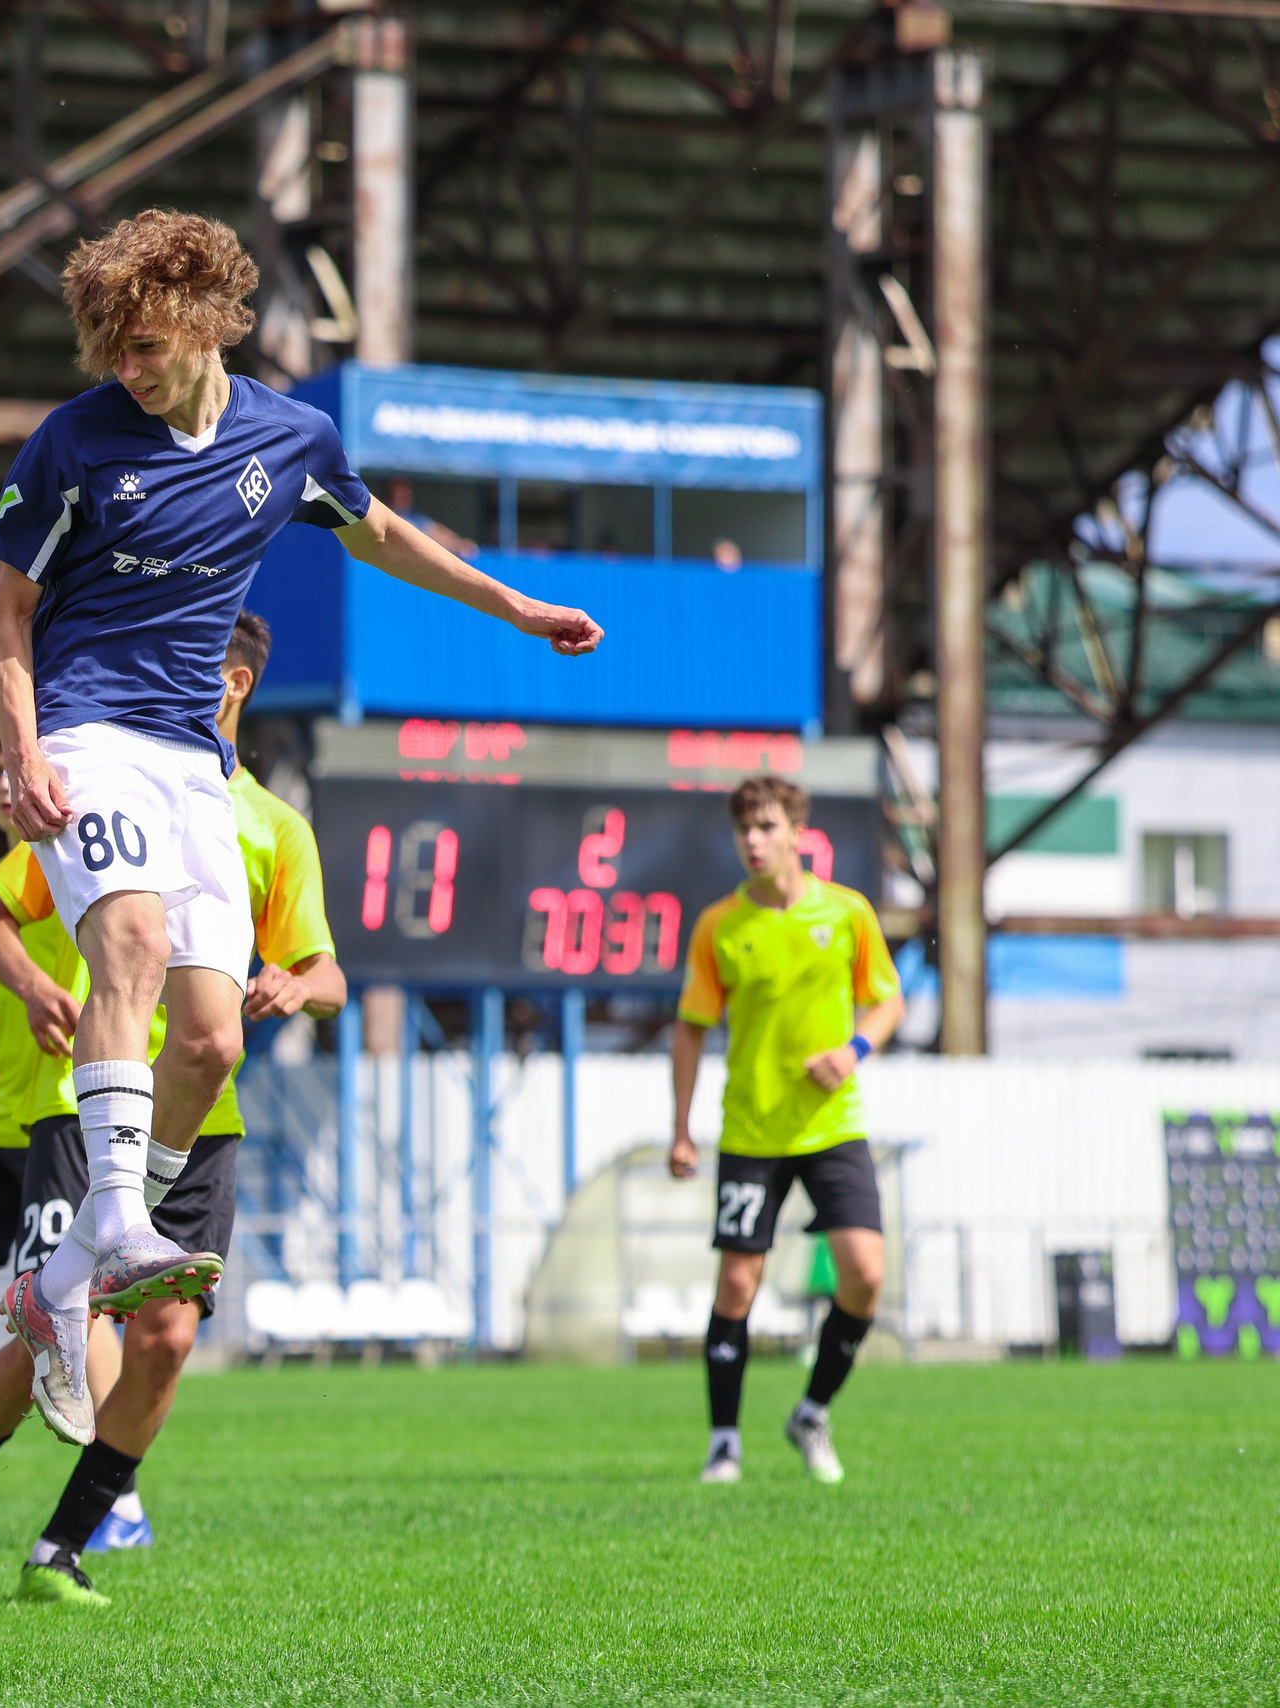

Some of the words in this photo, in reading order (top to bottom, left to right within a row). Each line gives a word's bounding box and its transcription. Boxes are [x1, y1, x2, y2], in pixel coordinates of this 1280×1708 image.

[113, 492, 147, 500] KELME
[78, 810, 147, 871] 80
[109, 1138, 141, 1147] KELME
[718, 1181, 766, 1238] 27
[17, 1198, 74, 1273] 29
[15, 1280, 29, 1322] Kappa
